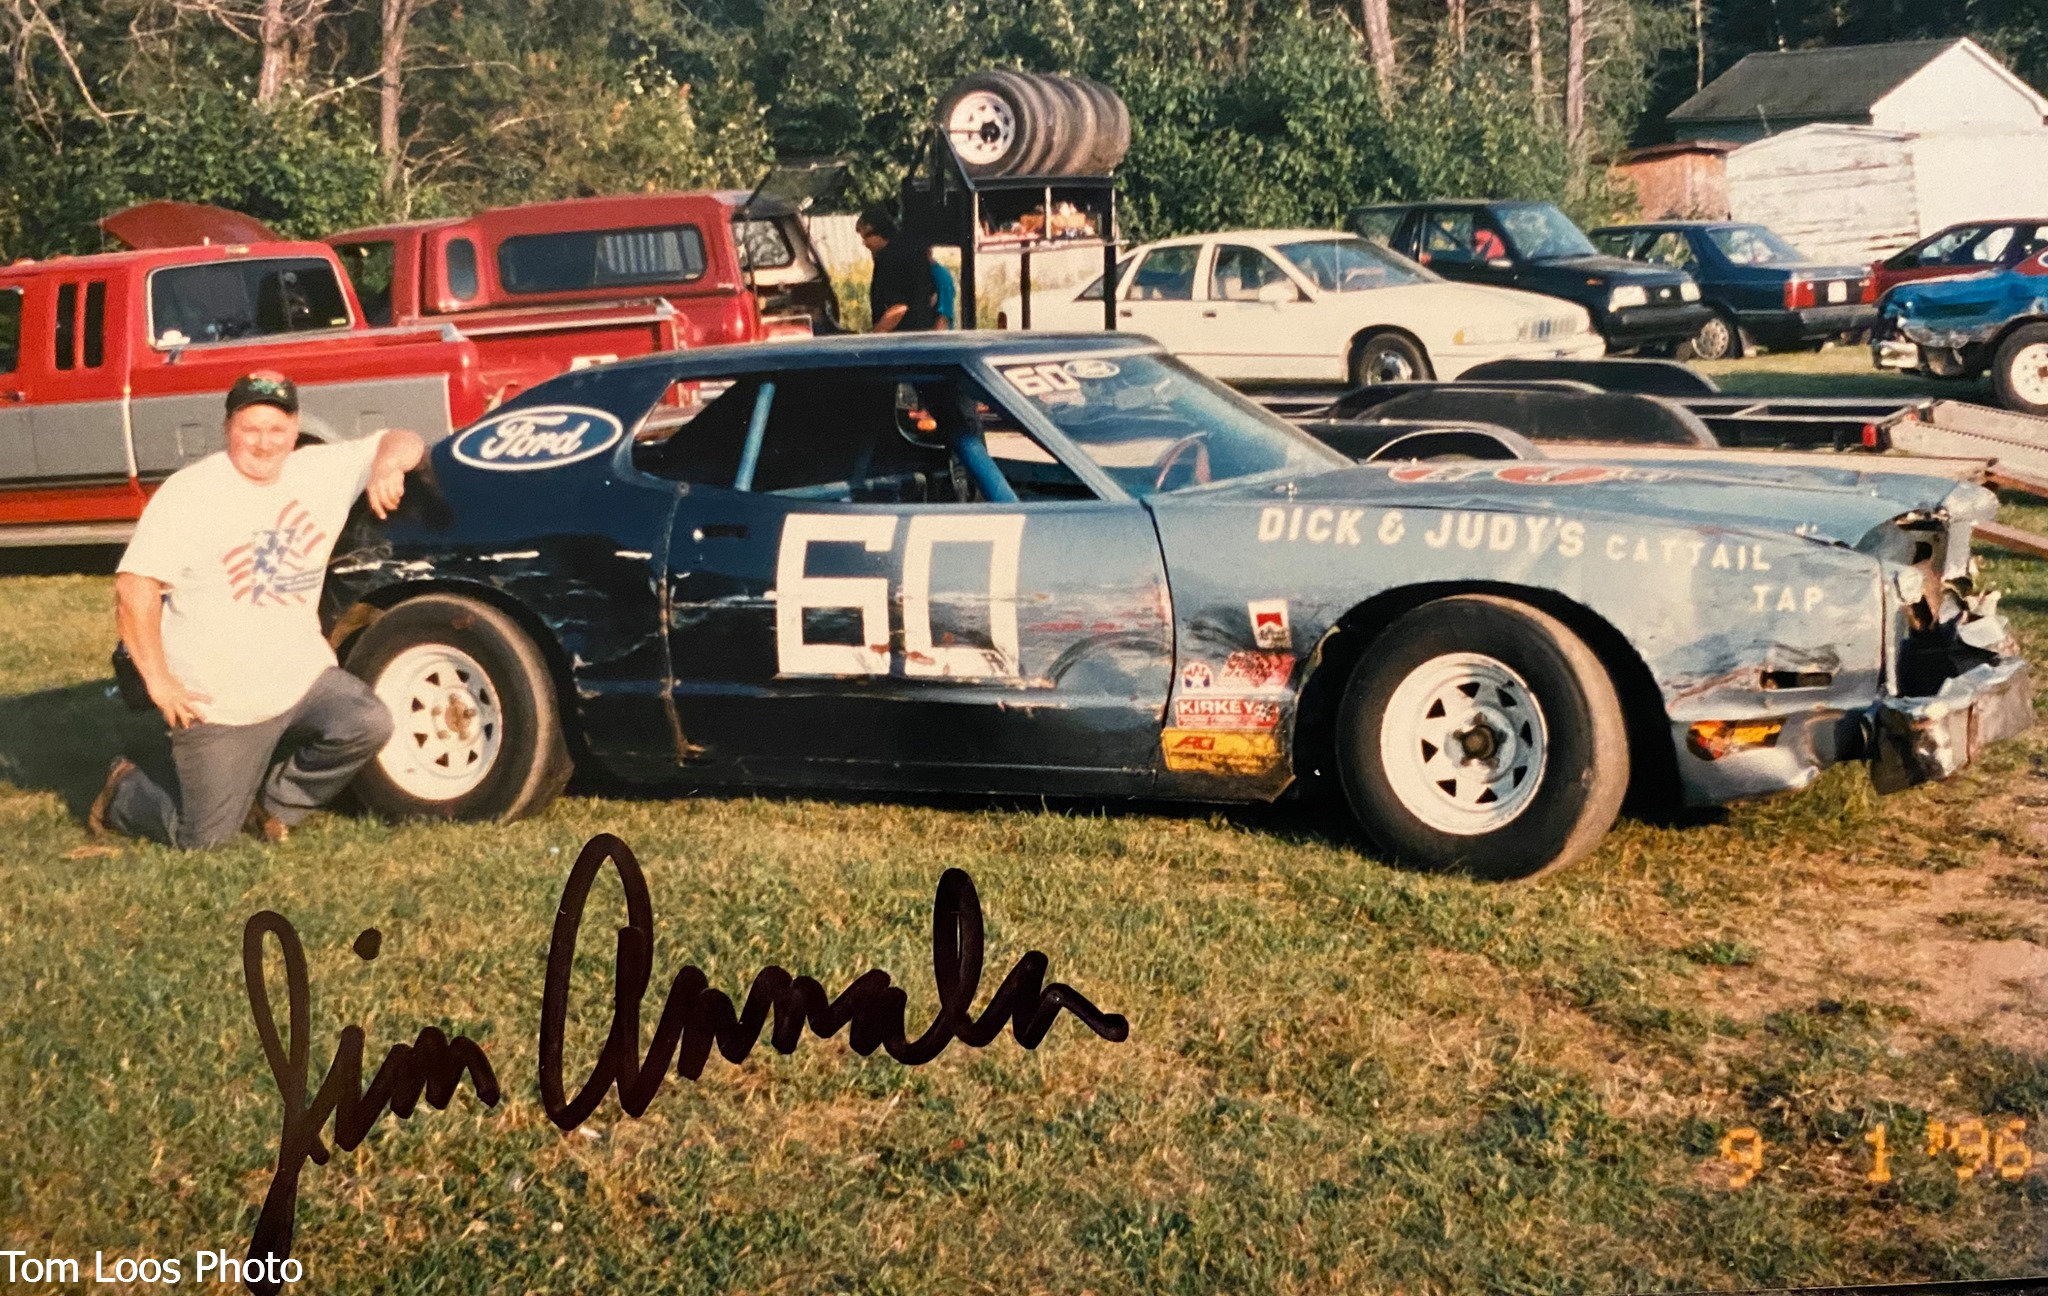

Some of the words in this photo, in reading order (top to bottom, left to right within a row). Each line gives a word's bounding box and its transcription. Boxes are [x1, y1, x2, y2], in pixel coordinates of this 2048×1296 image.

[1003, 363, 1081, 397] 60
[480, 413, 591, 461] Ford
[1257, 506, 1364, 547] DICK
[1377, 508, 1406, 546] &
[1424, 509, 1586, 558] JUDY'S
[1605, 534, 1772, 571] CATTAIL
[776, 513, 1026, 677] 60
[1752, 583, 1825, 613] TAP
[1179, 699, 1256, 715] KIRKEY
[242, 910, 501, 1296] Jim
